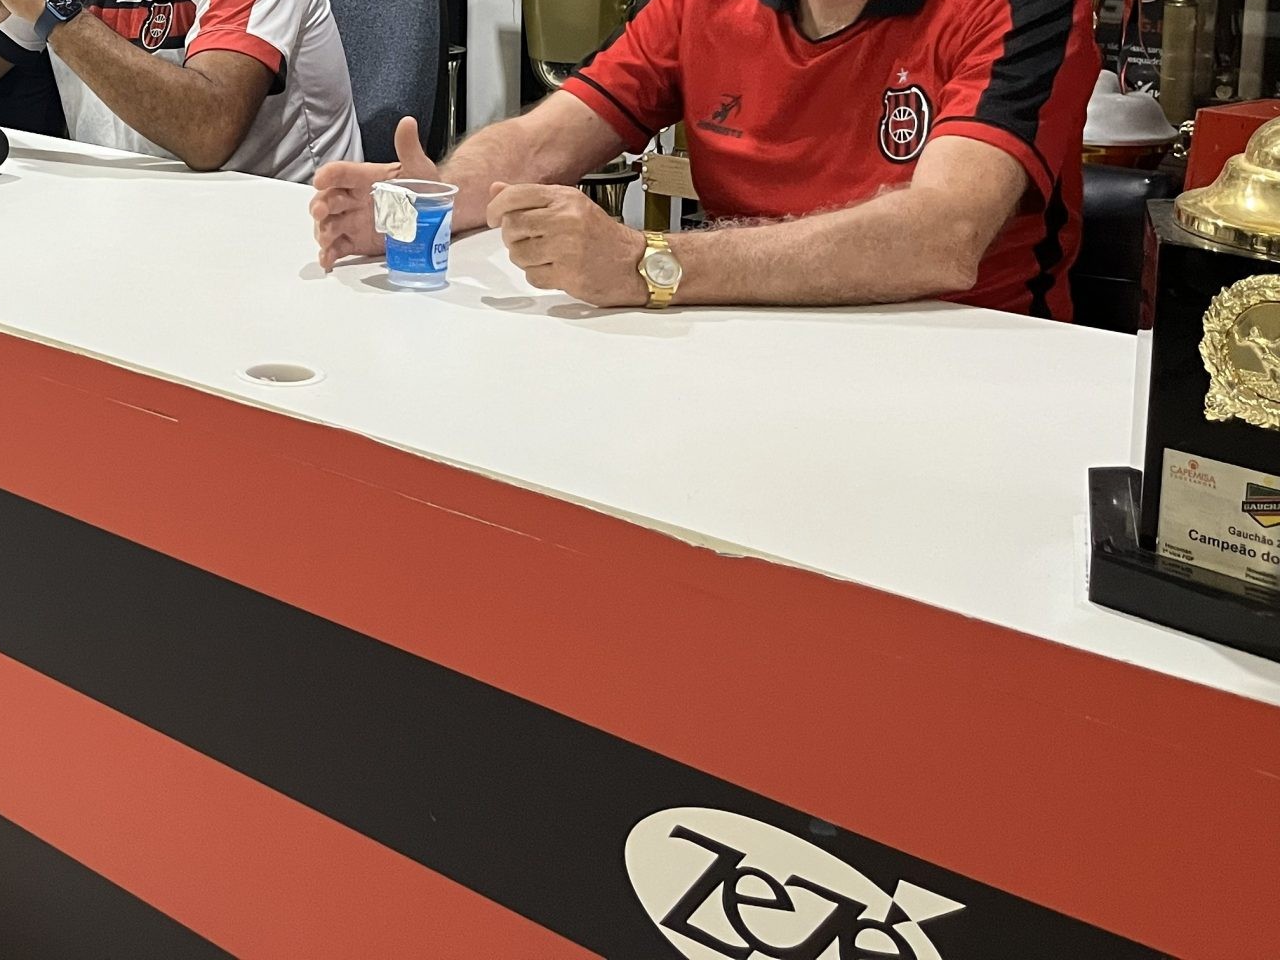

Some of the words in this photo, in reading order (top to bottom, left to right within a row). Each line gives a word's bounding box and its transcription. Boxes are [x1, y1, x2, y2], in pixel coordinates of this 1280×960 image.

[1170, 464, 1216, 484] CAPEMISA
[1228, 526, 1274, 546] Gauchão
[1188, 529, 1257, 558] Campeão
[1261, 551, 1280, 565] do
